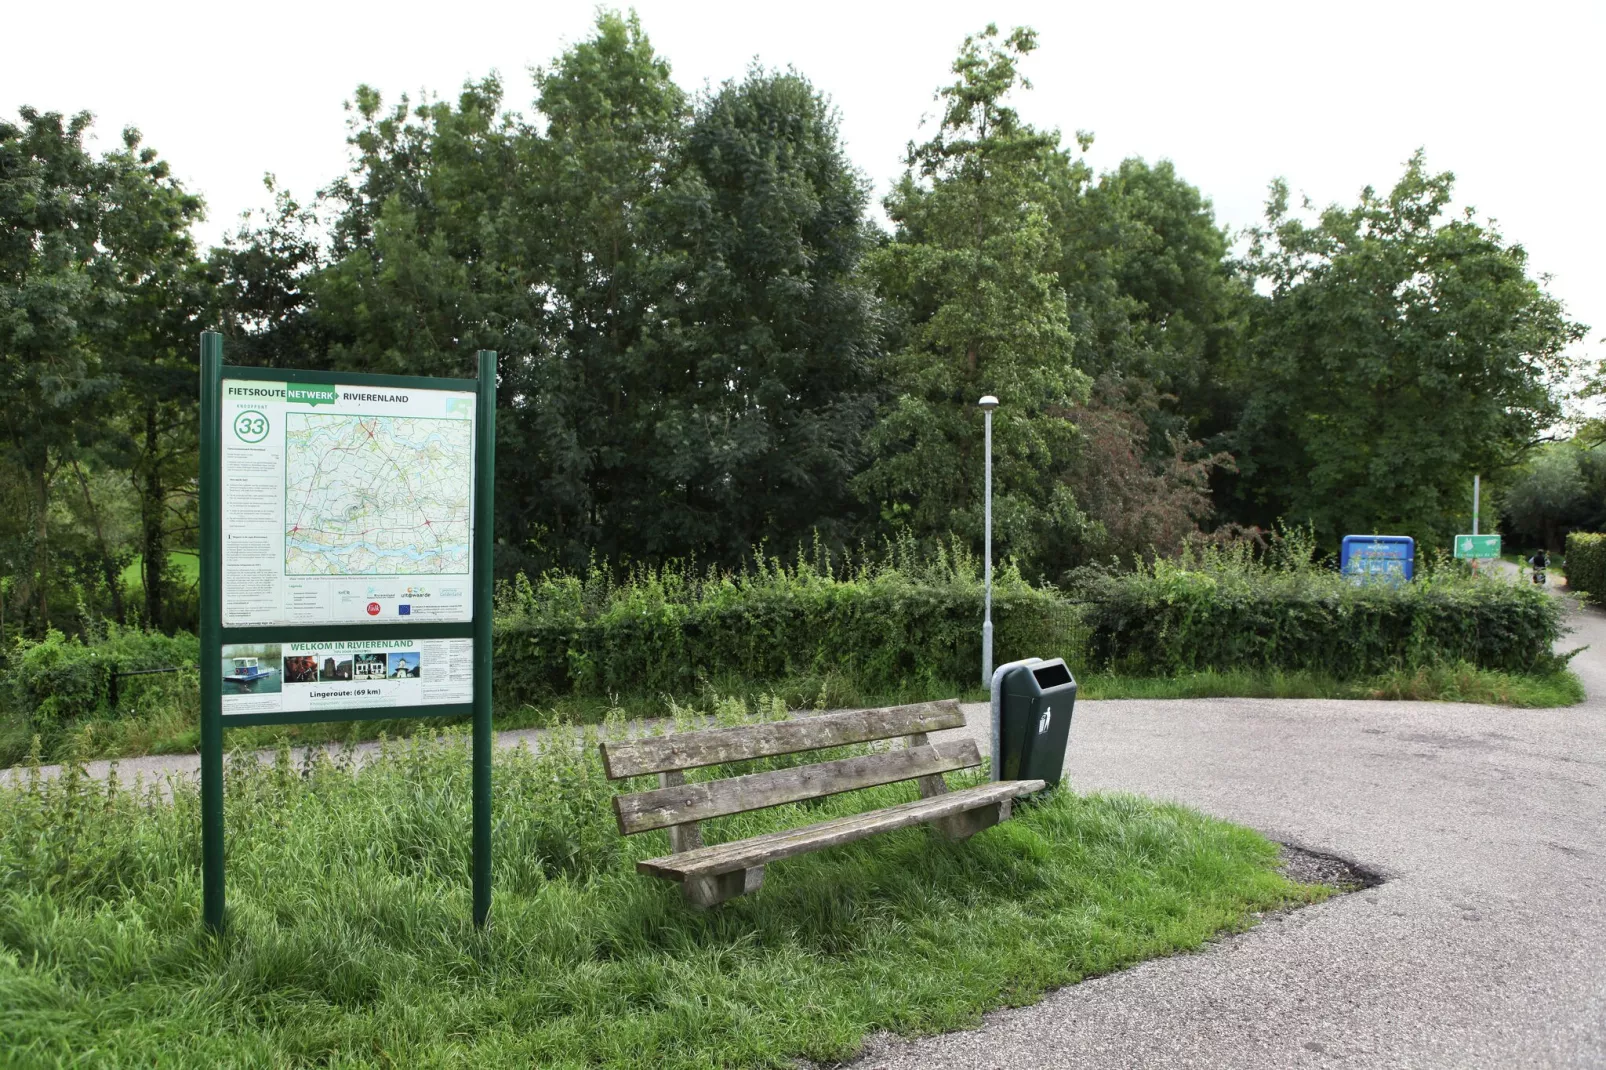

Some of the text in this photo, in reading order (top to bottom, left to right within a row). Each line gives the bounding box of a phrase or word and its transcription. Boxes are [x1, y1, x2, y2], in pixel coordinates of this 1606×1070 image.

[228, 388, 408, 403] FIETSROUTE NETWERK RIVIERENLAND
[239, 418, 264, 434] 33
[291, 642, 332, 651] WELKOM
[347, 640, 414, 649] RIVIERENLAND
